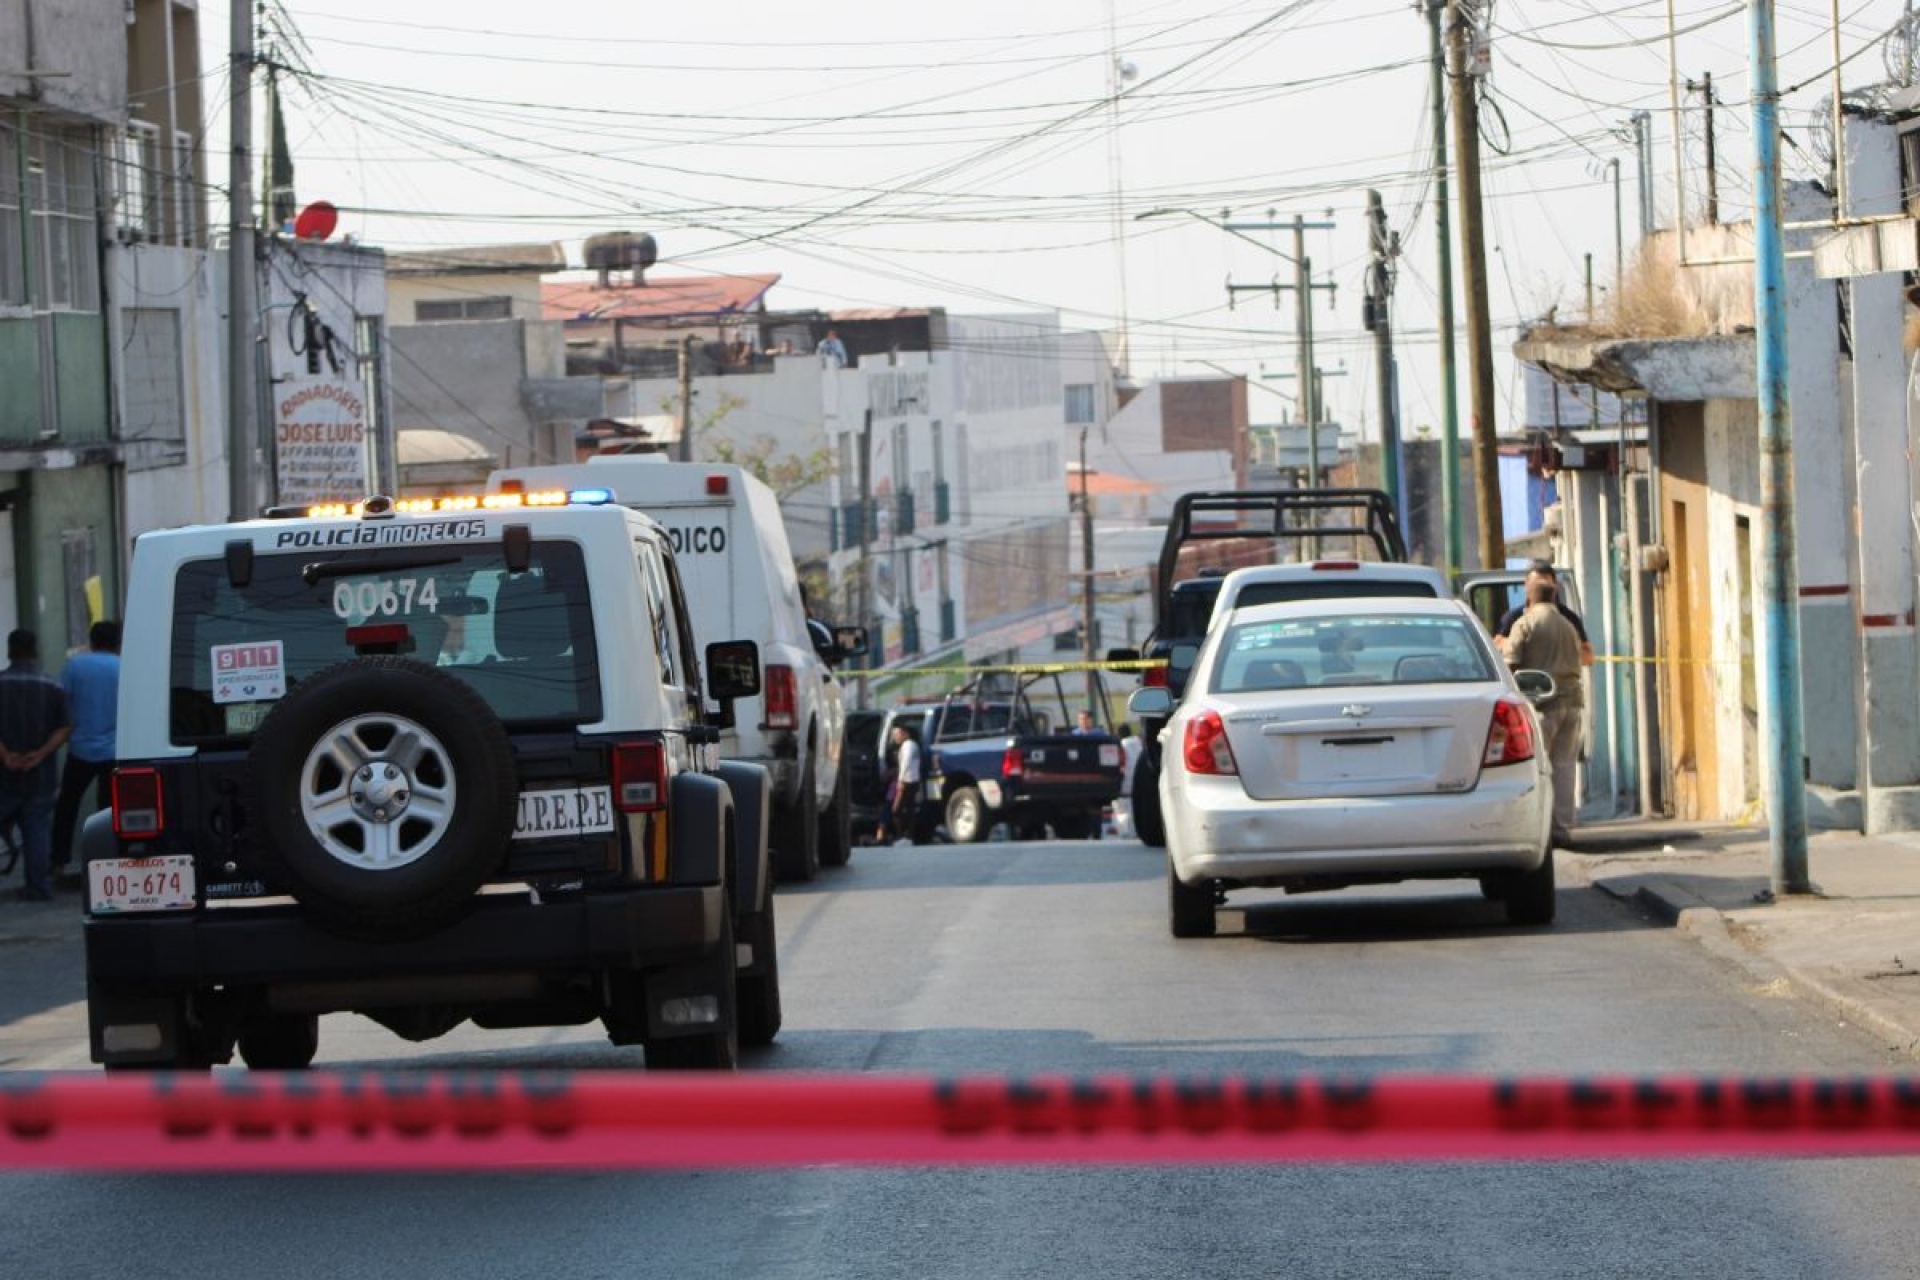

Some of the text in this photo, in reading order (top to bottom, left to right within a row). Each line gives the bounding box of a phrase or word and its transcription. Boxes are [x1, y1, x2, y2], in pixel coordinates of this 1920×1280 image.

[281, 384, 362, 418] RADIADORES
[280, 423, 363, 443] JOSE LUIS
[382, 520, 486, 543] MORELOS
[669, 527, 726, 553] DICO
[333, 578, 439, 618] 00674
[220, 647, 273, 668] 911
[103, 872, 180, 896] 00-674
